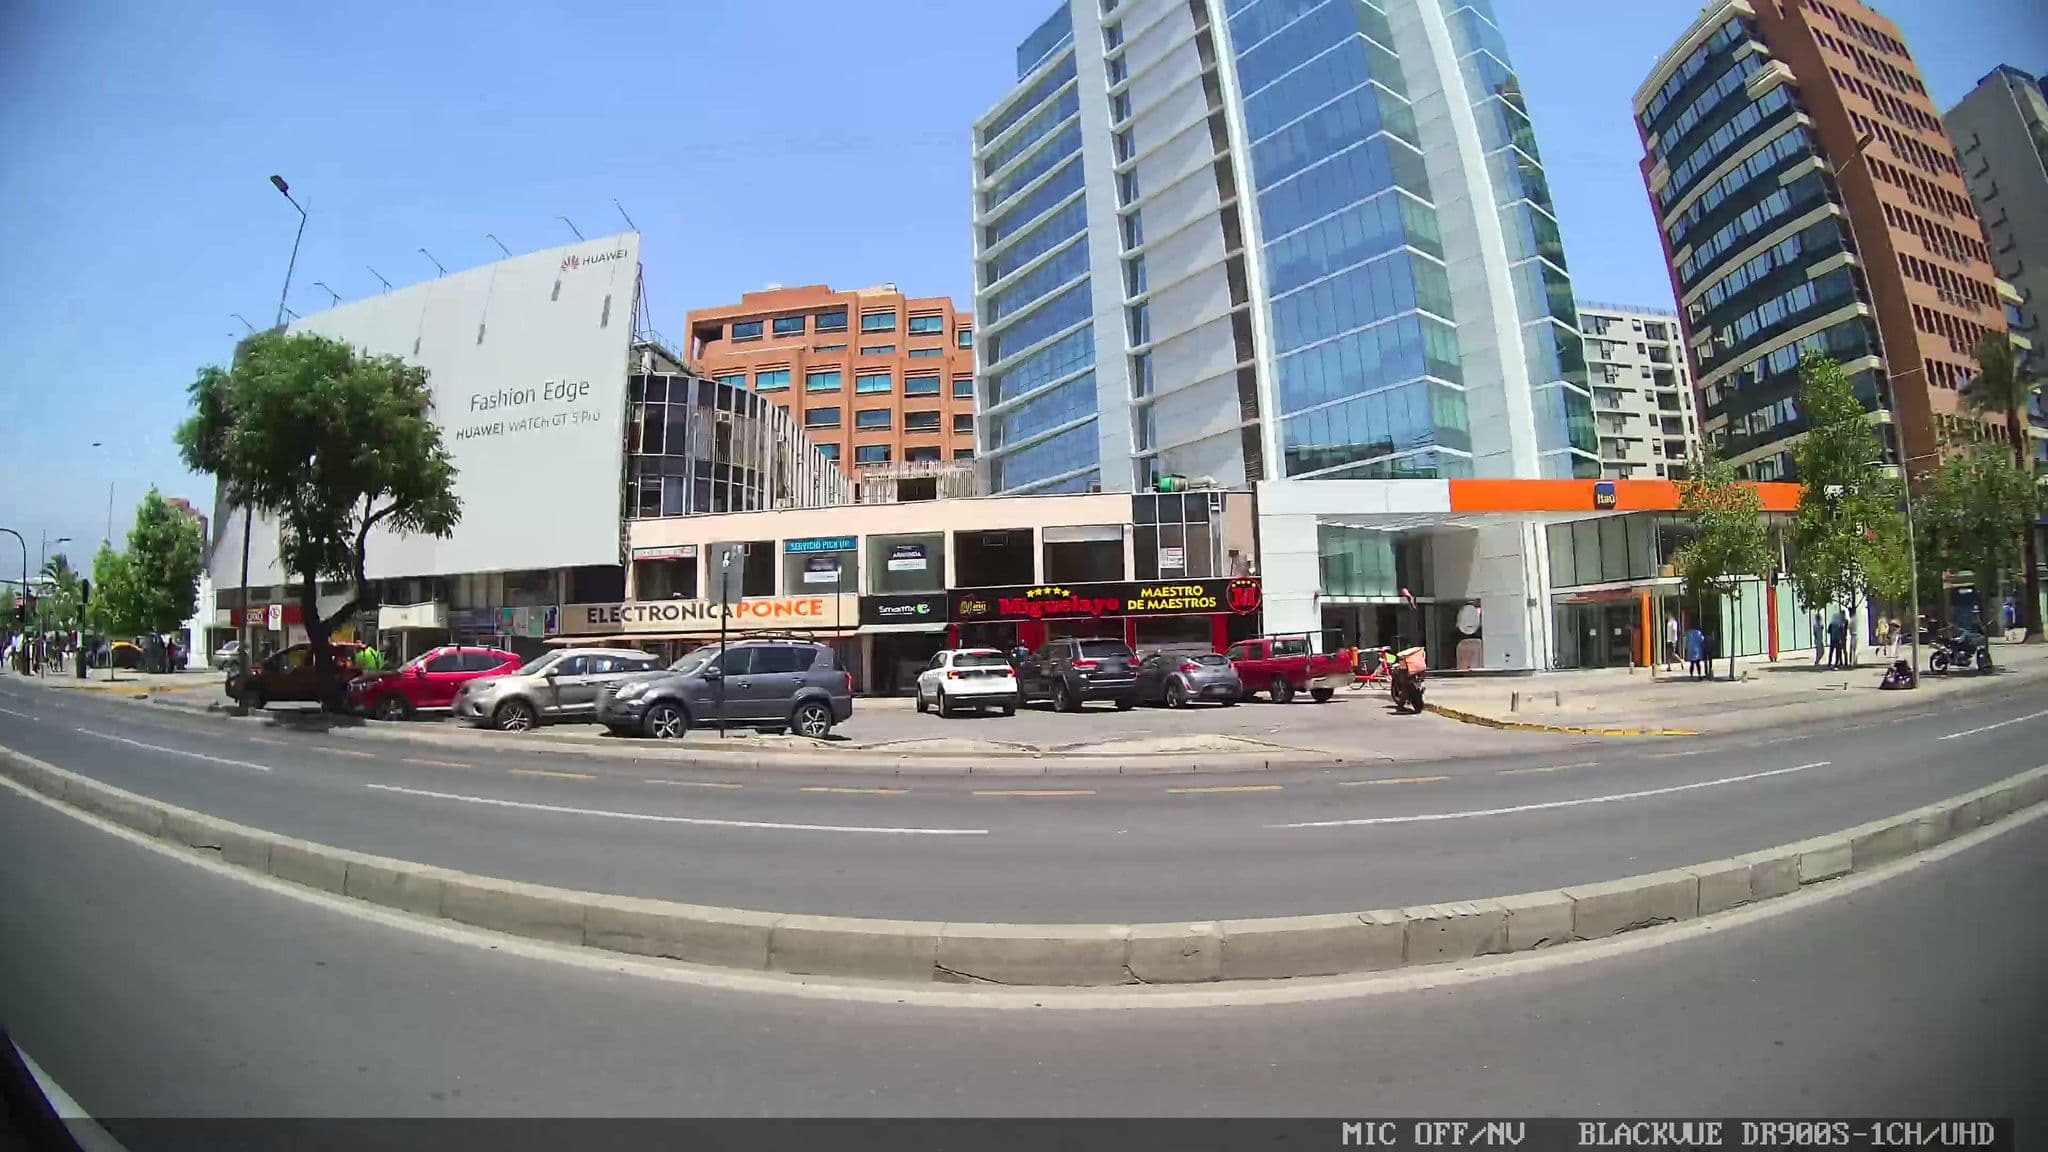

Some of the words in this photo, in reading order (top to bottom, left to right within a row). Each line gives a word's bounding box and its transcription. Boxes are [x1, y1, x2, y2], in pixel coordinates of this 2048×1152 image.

[583, 249, 628, 266] HUAWEI
[471, 387, 535, 412] Fashion
[544, 379, 590, 403] Edge
[456, 422, 504, 440] HUAWEI
[553, 413, 568, 426] GT
[790, 541, 821, 551] SERVICIO
[822, 540, 838, 550] PICK
[839, 539, 851, 549] UP
[1140, 585, 1203, 598] MAESTRO
[736, 599, 823, 618] PONCE
[1127, 598, 1145, 610] DE
[1147, 596, 1217, 610] MAESTROS
